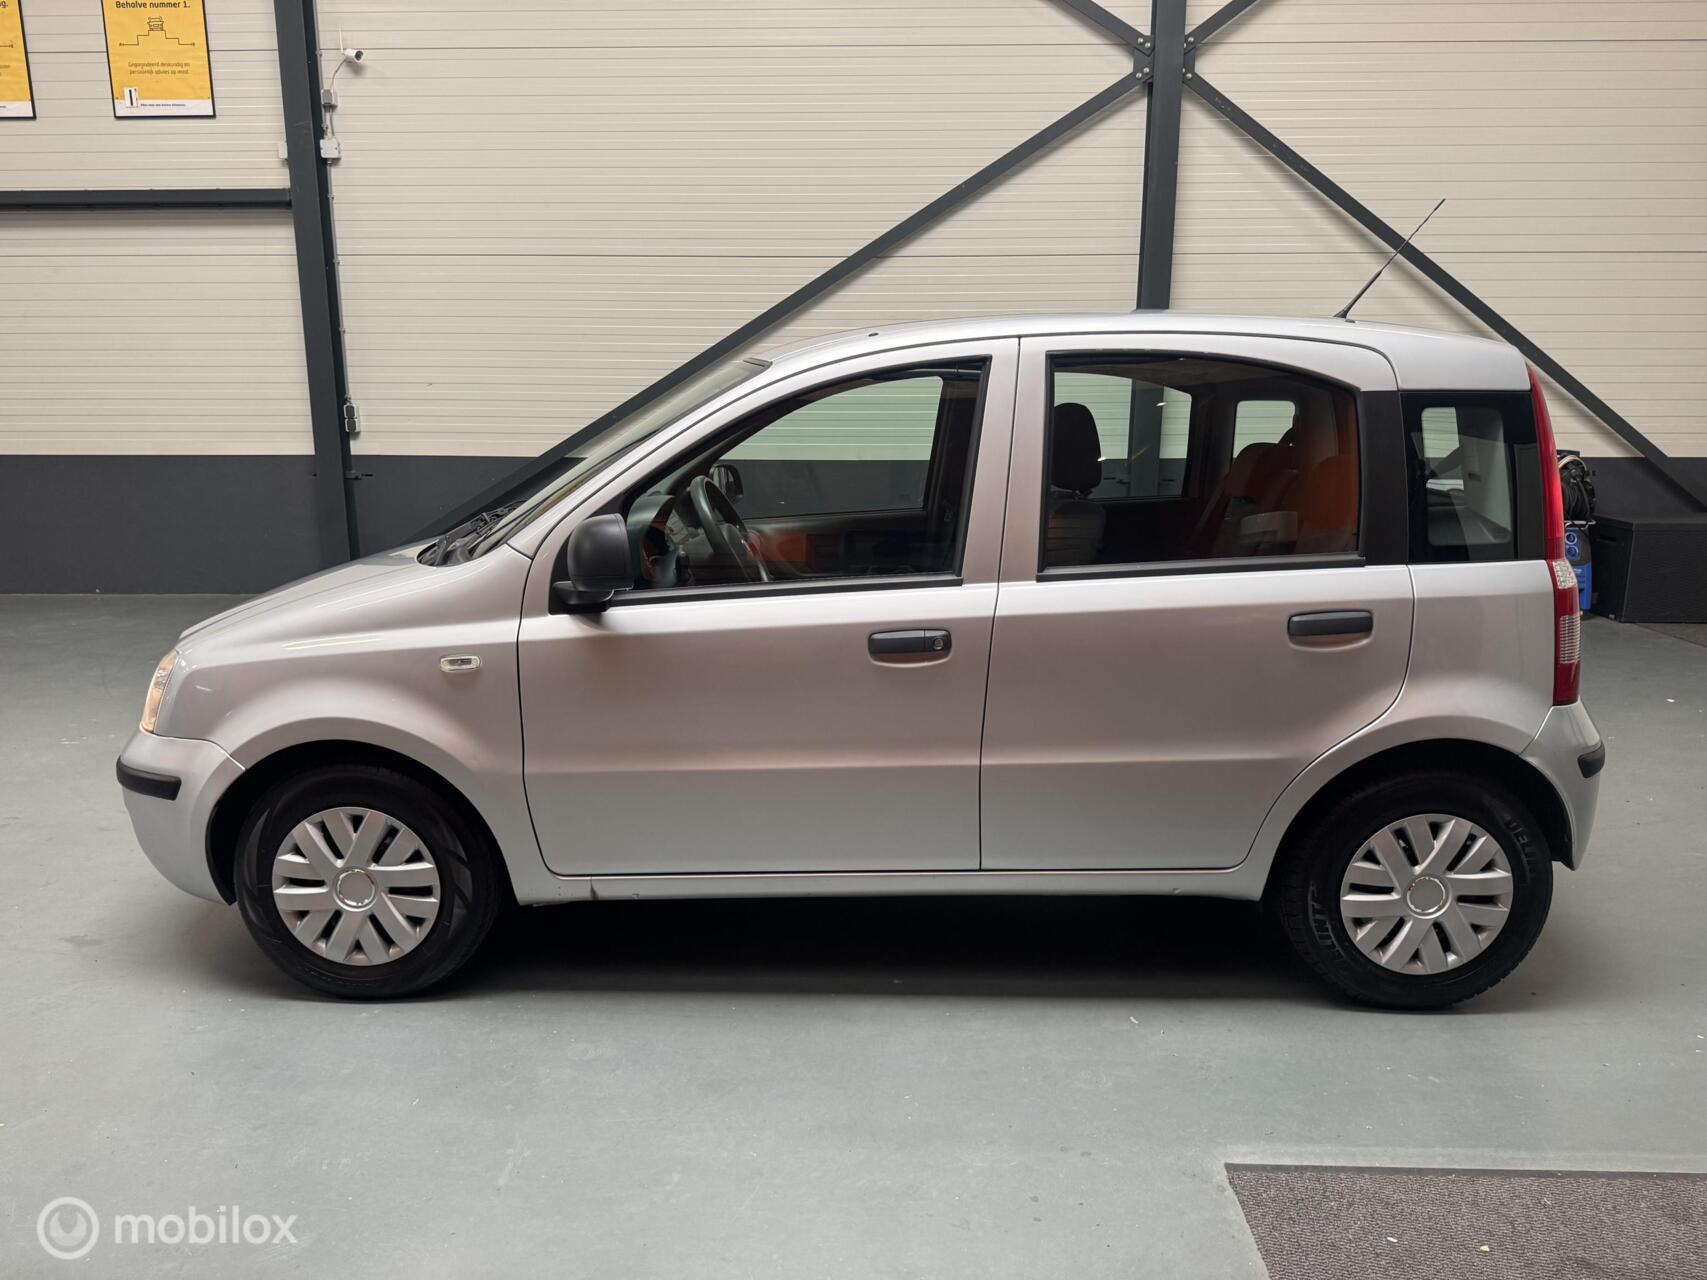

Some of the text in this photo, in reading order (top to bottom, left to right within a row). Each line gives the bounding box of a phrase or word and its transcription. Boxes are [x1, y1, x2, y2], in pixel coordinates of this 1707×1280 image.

[115, 0, 190, 9] Behalve nummer 1.
